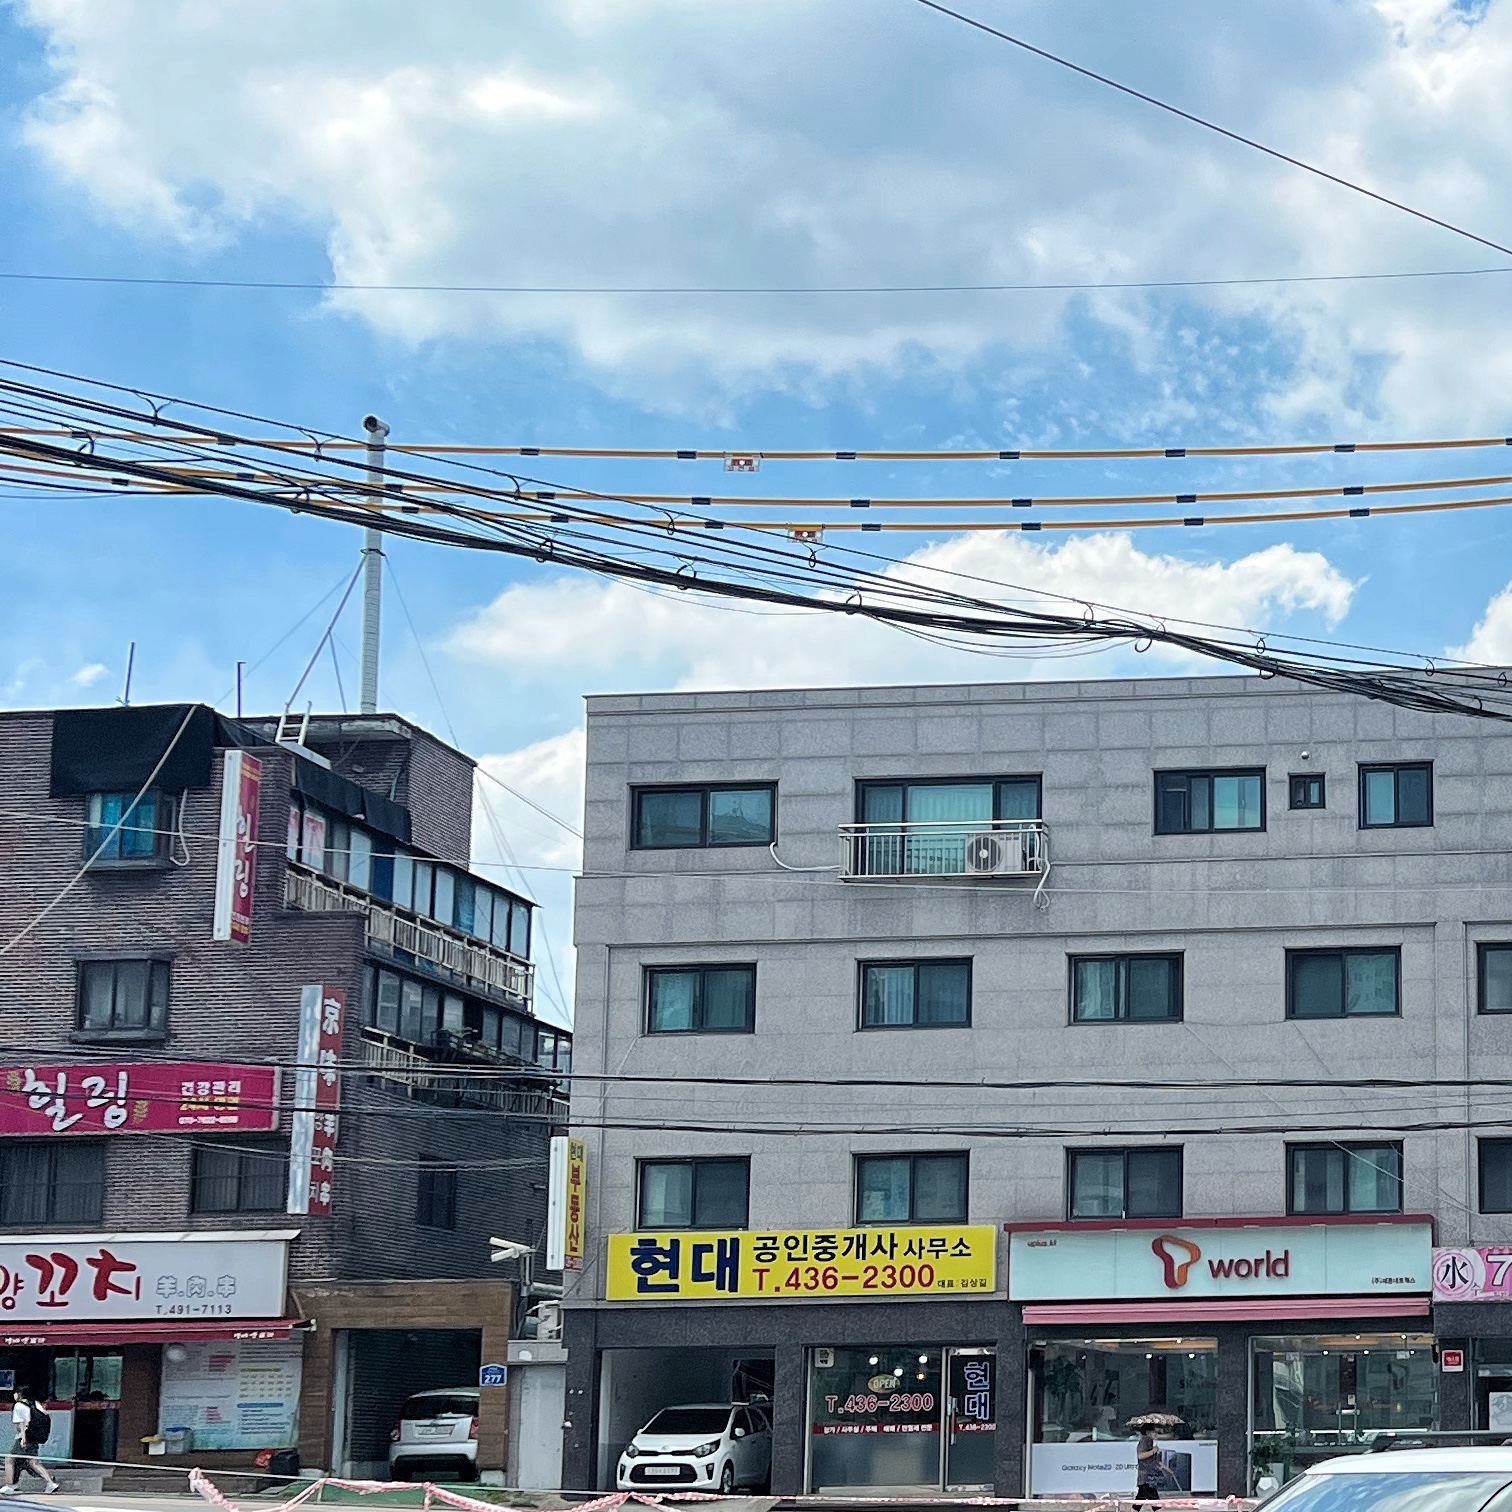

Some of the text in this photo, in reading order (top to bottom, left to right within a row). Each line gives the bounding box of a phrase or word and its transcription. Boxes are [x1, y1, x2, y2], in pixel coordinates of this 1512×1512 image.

[22, 1068, 129, 1131] 힐링
[629, 1233, 973, 1294] 현대 공인중개사 사무소
[752, 1263, 935, 1293] T.436-2300
[1207, 1249, 1290, 1280] world
[1439, 1256, 1470, 1289] 水
[155, 1303, 233, 1316] T.491-7113
[483, 1374, 502, 1384] 277
[963, 1361, 990, 1421] 현대
[825, 1392, 935, 1414] T.436-2300
